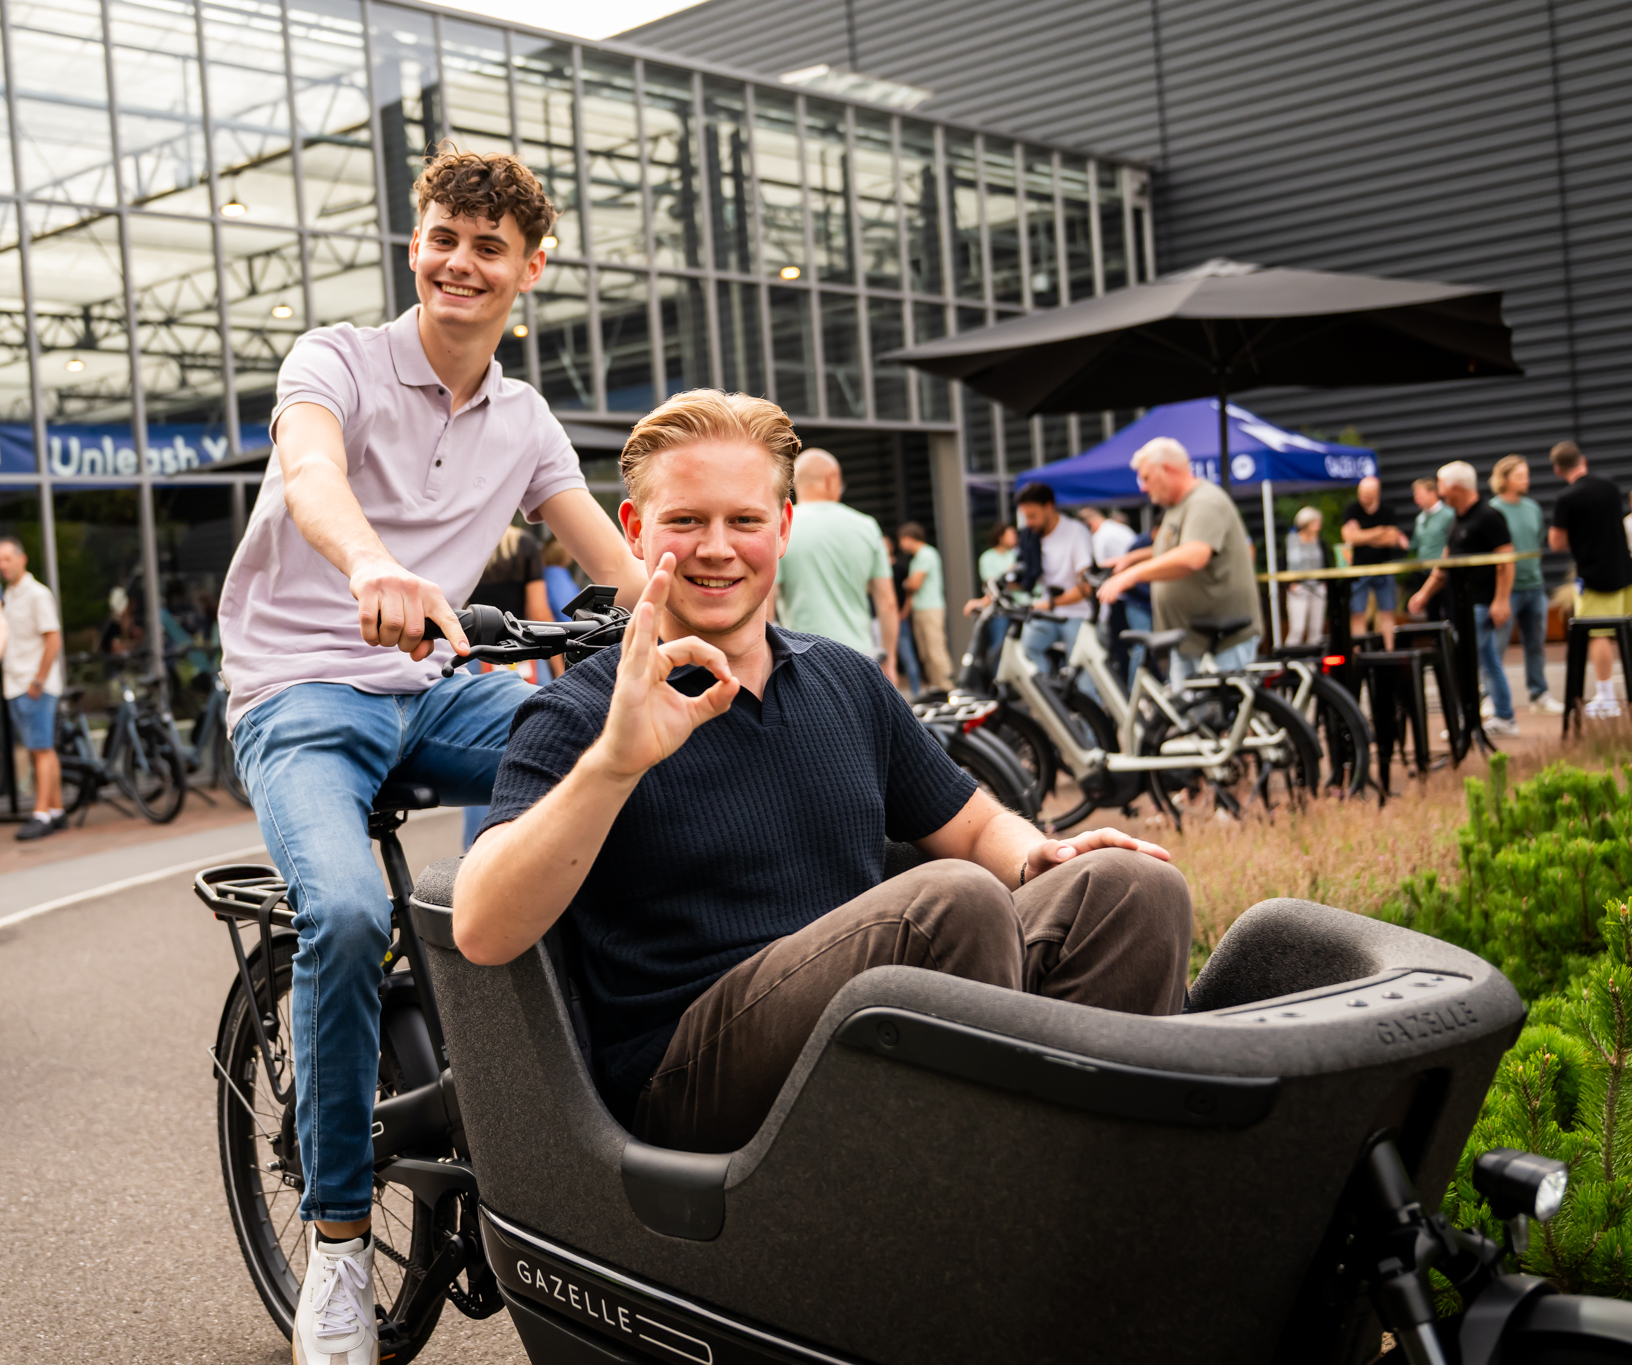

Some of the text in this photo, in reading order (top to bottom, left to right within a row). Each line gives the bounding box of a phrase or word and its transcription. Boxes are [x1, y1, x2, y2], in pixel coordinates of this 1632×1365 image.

[51, 435, 200, 477] Unleash
[1376, 1001, 1478, 1045] GAZELLE
[516, 1260, 633, 1333] GAZELLE
